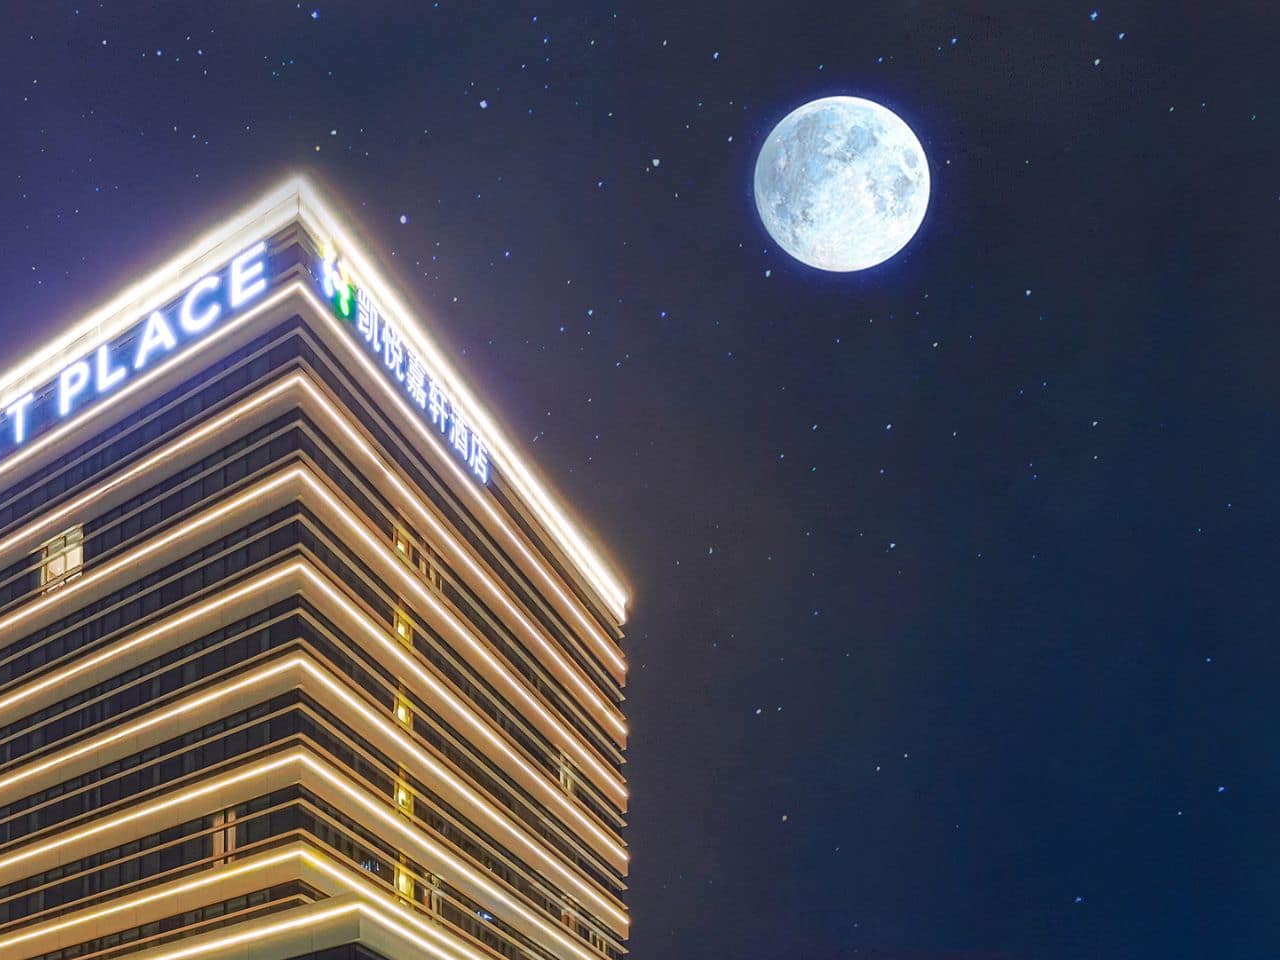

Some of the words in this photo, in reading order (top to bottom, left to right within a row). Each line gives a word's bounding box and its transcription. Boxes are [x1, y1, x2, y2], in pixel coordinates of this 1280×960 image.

[58, 240, 269, 417] PLACE
[355, 287, 490, 485] 凯悦嘉轩酒店
